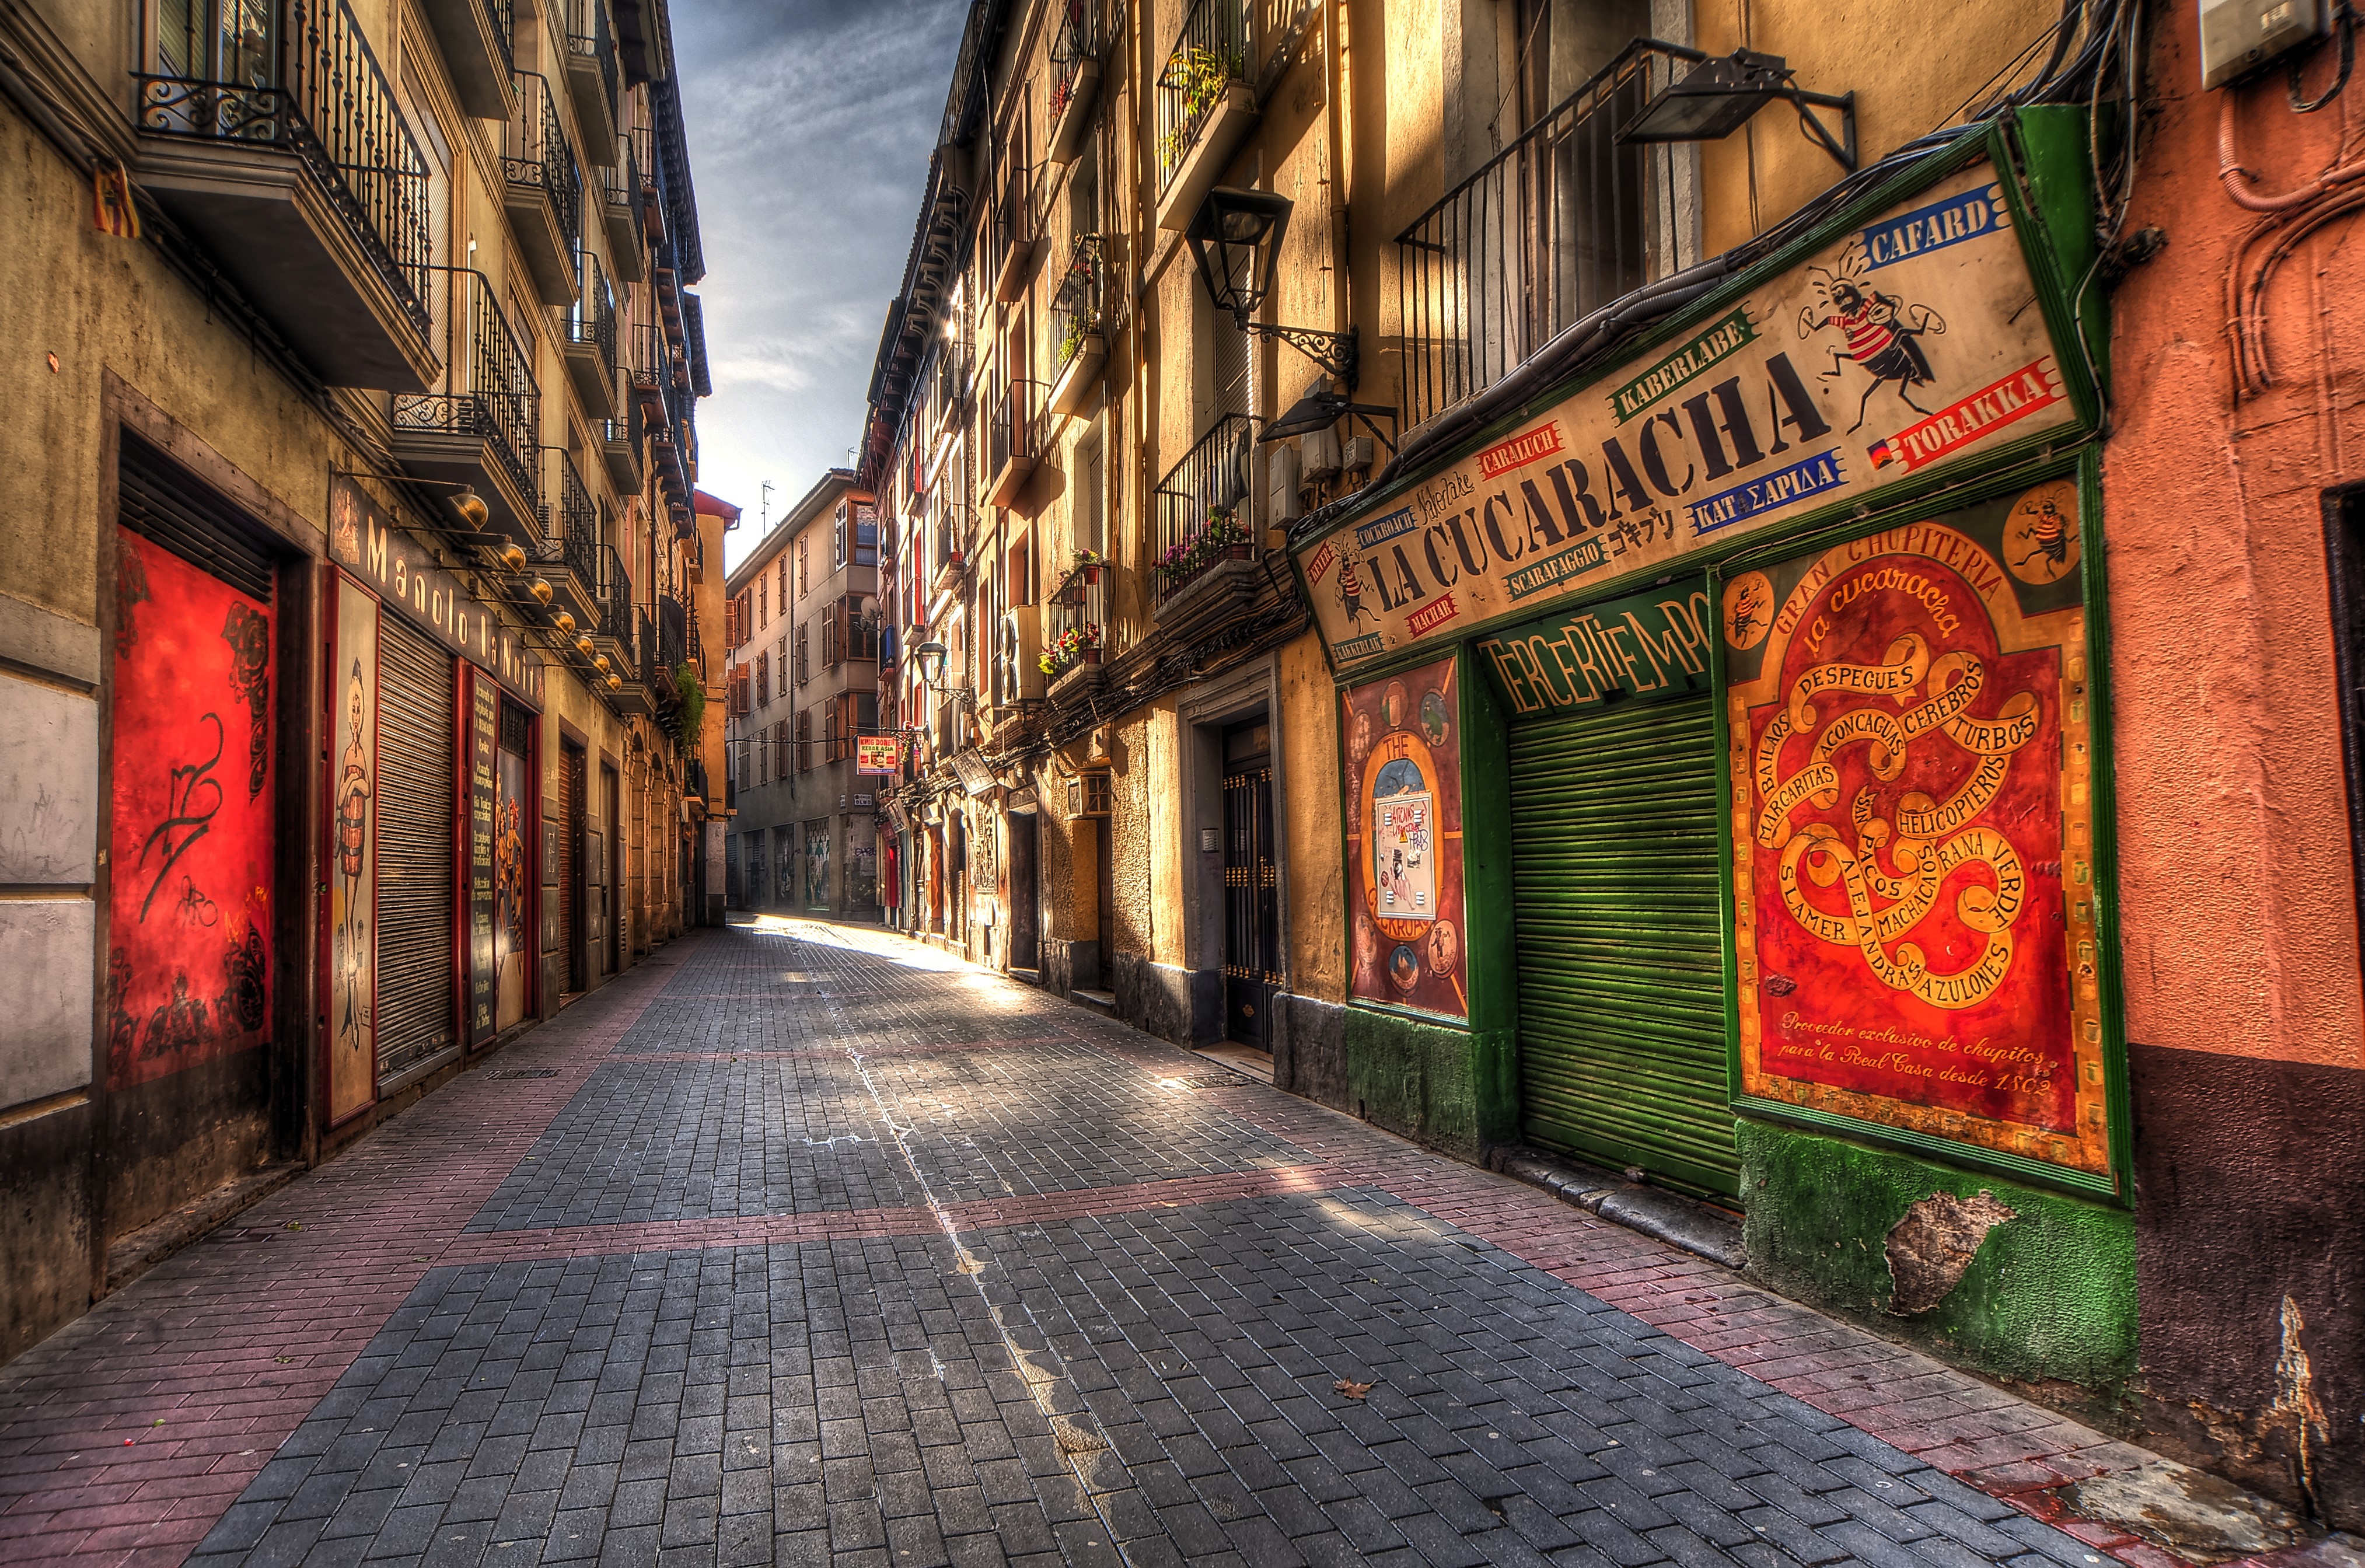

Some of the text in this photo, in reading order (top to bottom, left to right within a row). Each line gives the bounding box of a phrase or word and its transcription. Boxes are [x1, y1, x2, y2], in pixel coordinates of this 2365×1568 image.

[1871, 199, 1989, 264] CAFARD
[1618, 320, 1744, 415] KABERLABE
[1482, 429, 1554, 474] CARALUCH
[1902, 372, 2048, 461] TORAKKA
[1366, 351, 1832, 613] LA CUCARACHA
[1359, 512, 1413, 546] COCKROACH
[367, 515, 467, 645] Manolo
[503, 636, 534, 696] Nuit
[1510, 542, 1600, 595] SCARAFAGGIO
[1776, 525, 2001, 635] GRAN CHUPITERIA
[1411, 600, 1452, 633] MACHAR
[1802, 567, 1960, 658] la cucaracha
[1800, 665, 1914, 696] DESPEGUES
[1904, 659, 1983, 734] CEREBROS
[1383, 735, 1409, 760] THE
[1761, 713, 1790, 794] BAILAOS
[1819, 713, 1905, 763] ACONCAGUAS
[1954, 714, 2036, 751] TURBOS
[1759, 766, 1835, 841] MARGARITAS
[1898, 755, 2006, 834] HELICOPTEROS
[1856, 796, 1903, 898] SAN PACOS
[1938, 832, 2022, 929] RANA VERDE
[1780, 864, 1847, 940] SLAMER
[1918, 942, 2008, 1003] AZULONES
[1778, 1044, 1814, 1060] para
[1819, 1044, 1835, 1061] la
[1840, 1045, 1887, 1070] Real
[1892, 1054, 1934, 1078] Casa
[1938, 1066, 1988, 1087] desde
[1781, 1010, 1855, 1037] Proveedor
[1857, 1023, 1933, 1050] exclusivo
[1938, 1033, 1959, 1052] de
